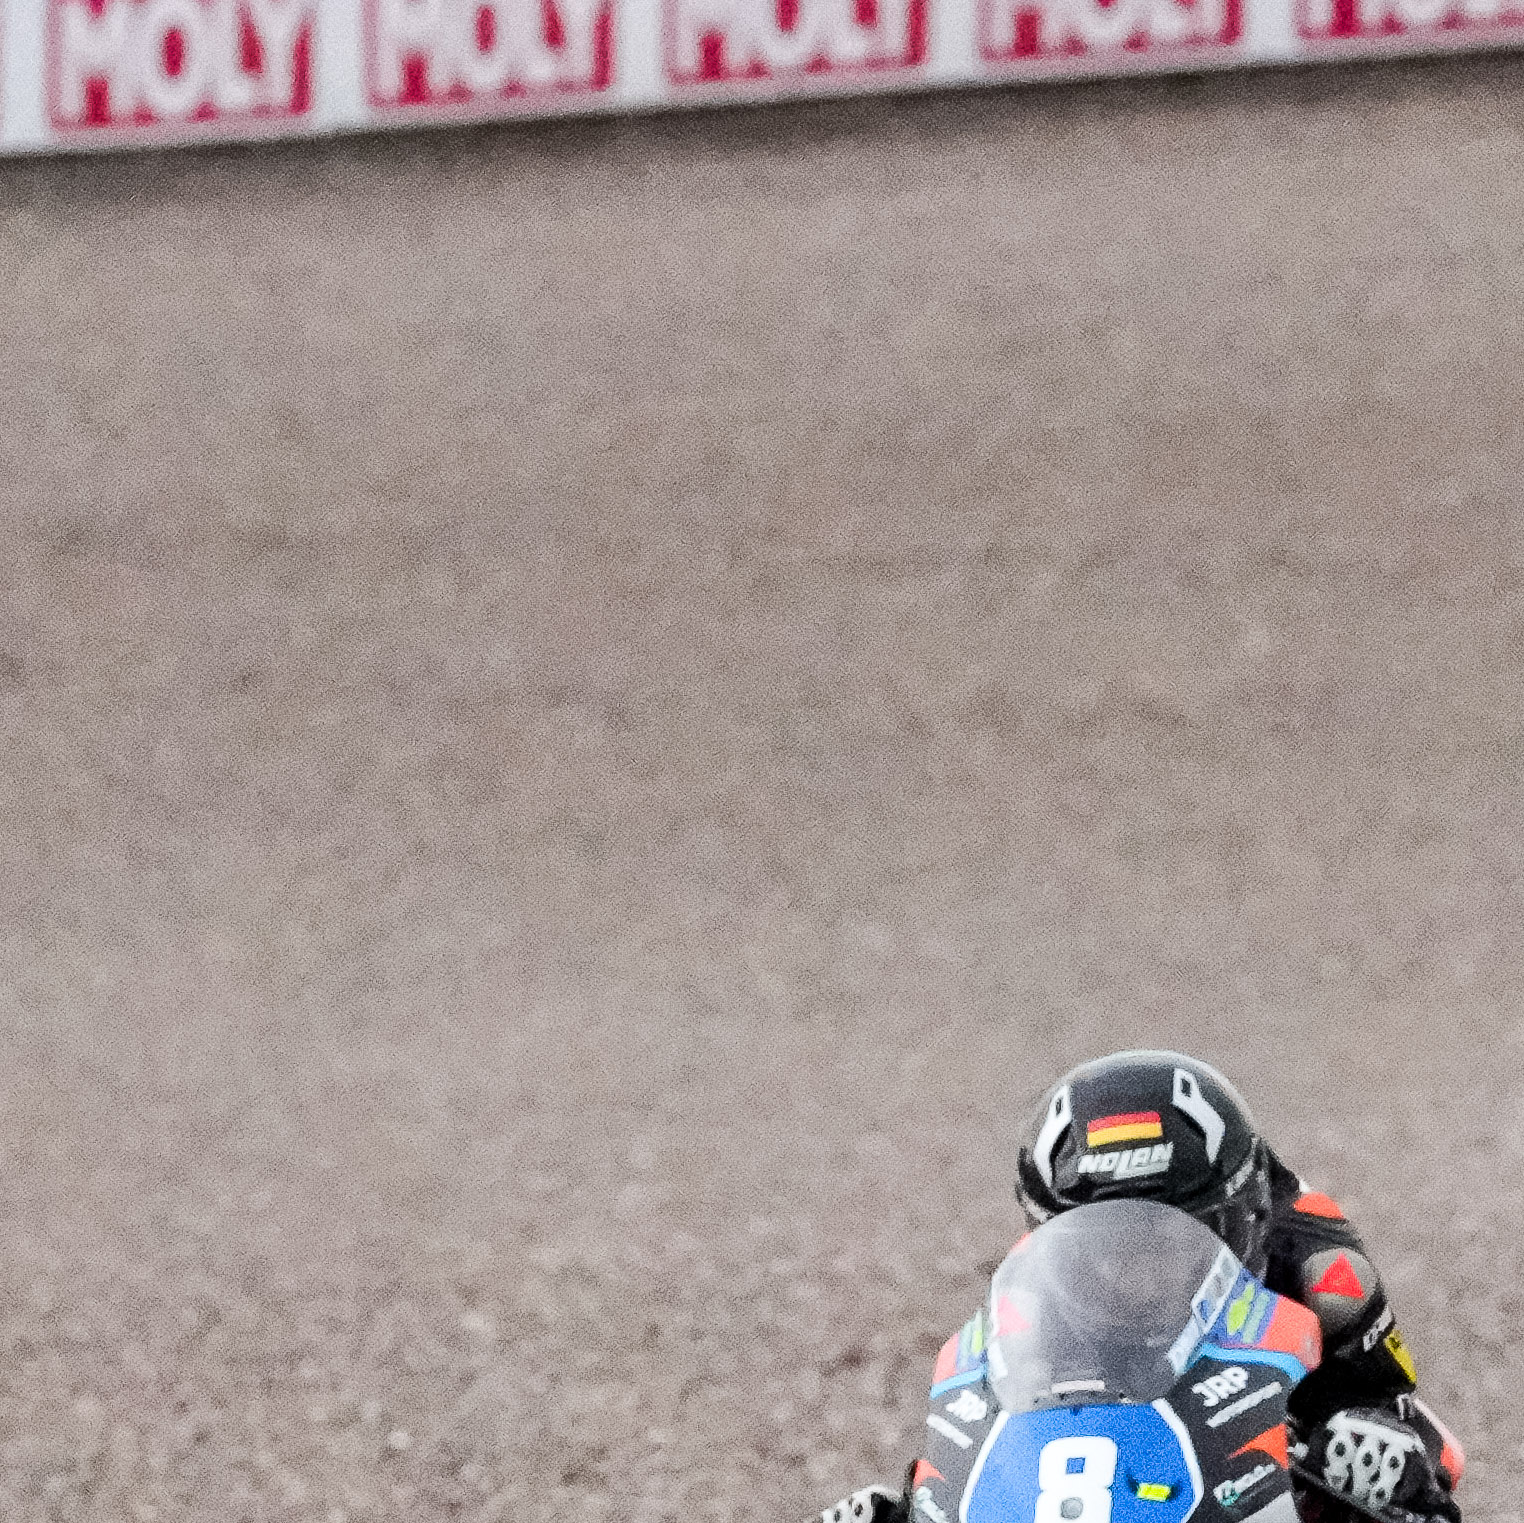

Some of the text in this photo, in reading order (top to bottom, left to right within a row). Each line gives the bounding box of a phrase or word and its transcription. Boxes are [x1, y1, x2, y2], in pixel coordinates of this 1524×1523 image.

[56, 0, 310, 122] MOLY
[370, 0, 602, 103] MOLY
[1077, 1142, 1173, 1180] NOLAN
[1192, 1366, 1249, 1407] JRP
